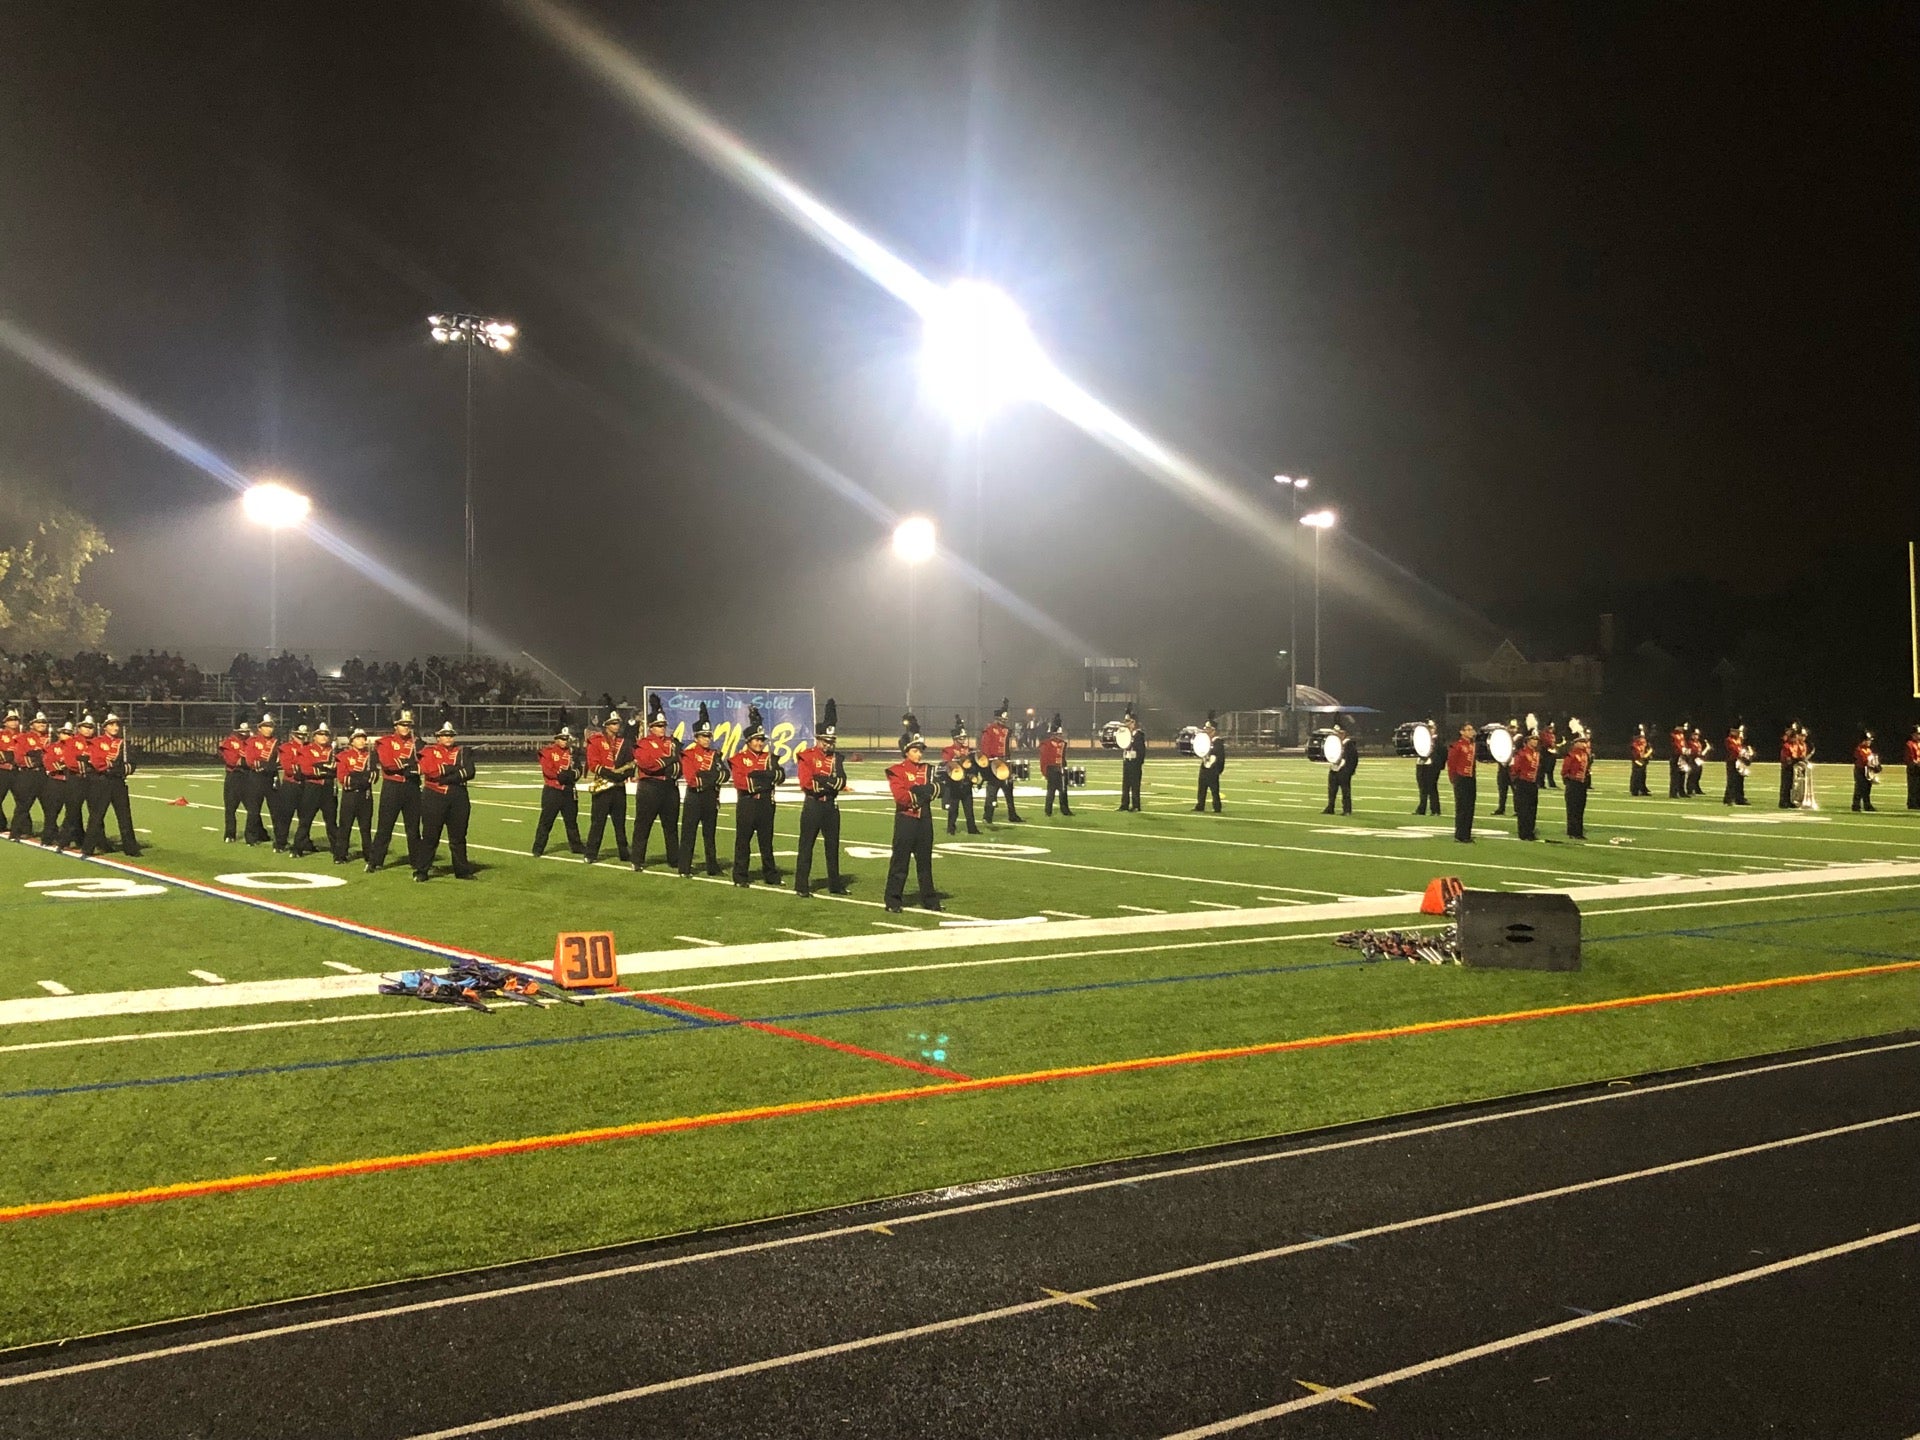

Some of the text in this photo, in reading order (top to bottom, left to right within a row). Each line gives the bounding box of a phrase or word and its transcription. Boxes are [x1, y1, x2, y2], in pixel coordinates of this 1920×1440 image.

[668, 694, 794, 711] Cirque du Soleil
[565, 935, 613, 980] 30
